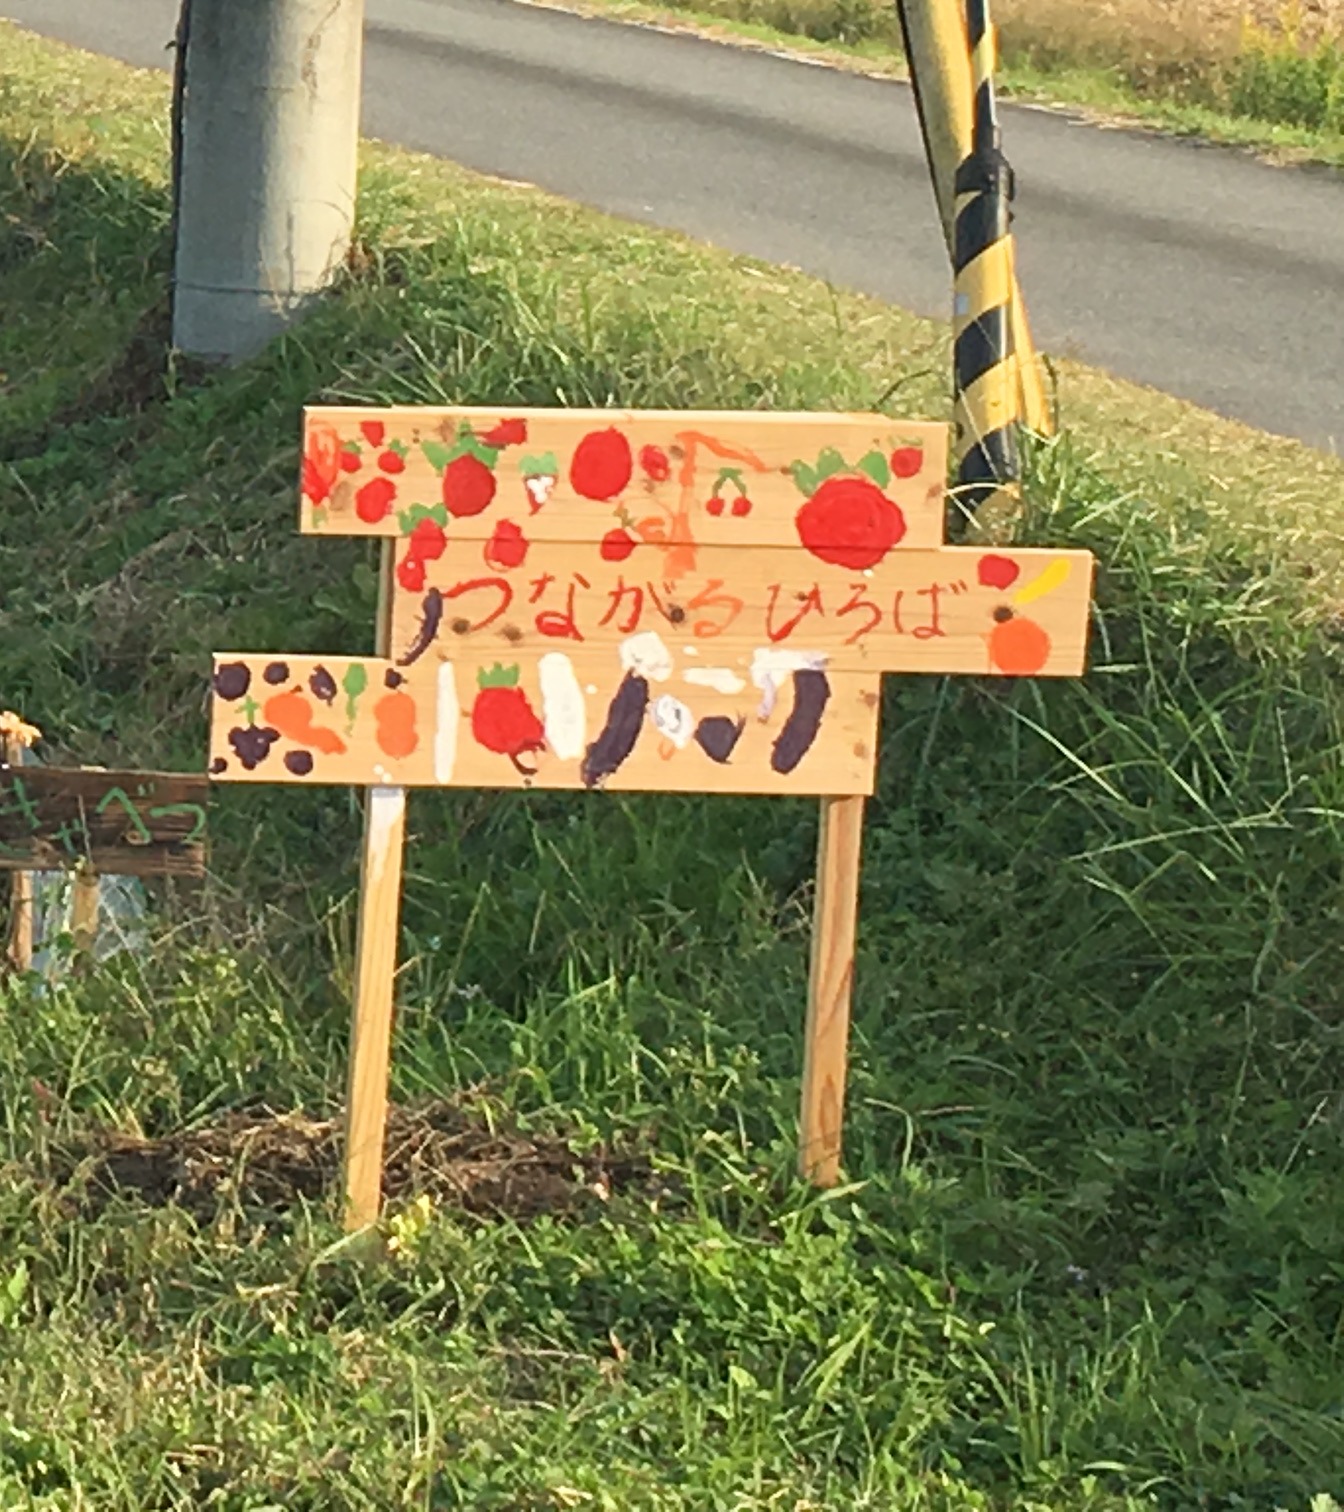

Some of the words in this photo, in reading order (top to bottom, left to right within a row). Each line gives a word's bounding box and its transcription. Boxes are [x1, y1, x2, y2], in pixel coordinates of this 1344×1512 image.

[442, 573, 969, 645] つながるひろば
